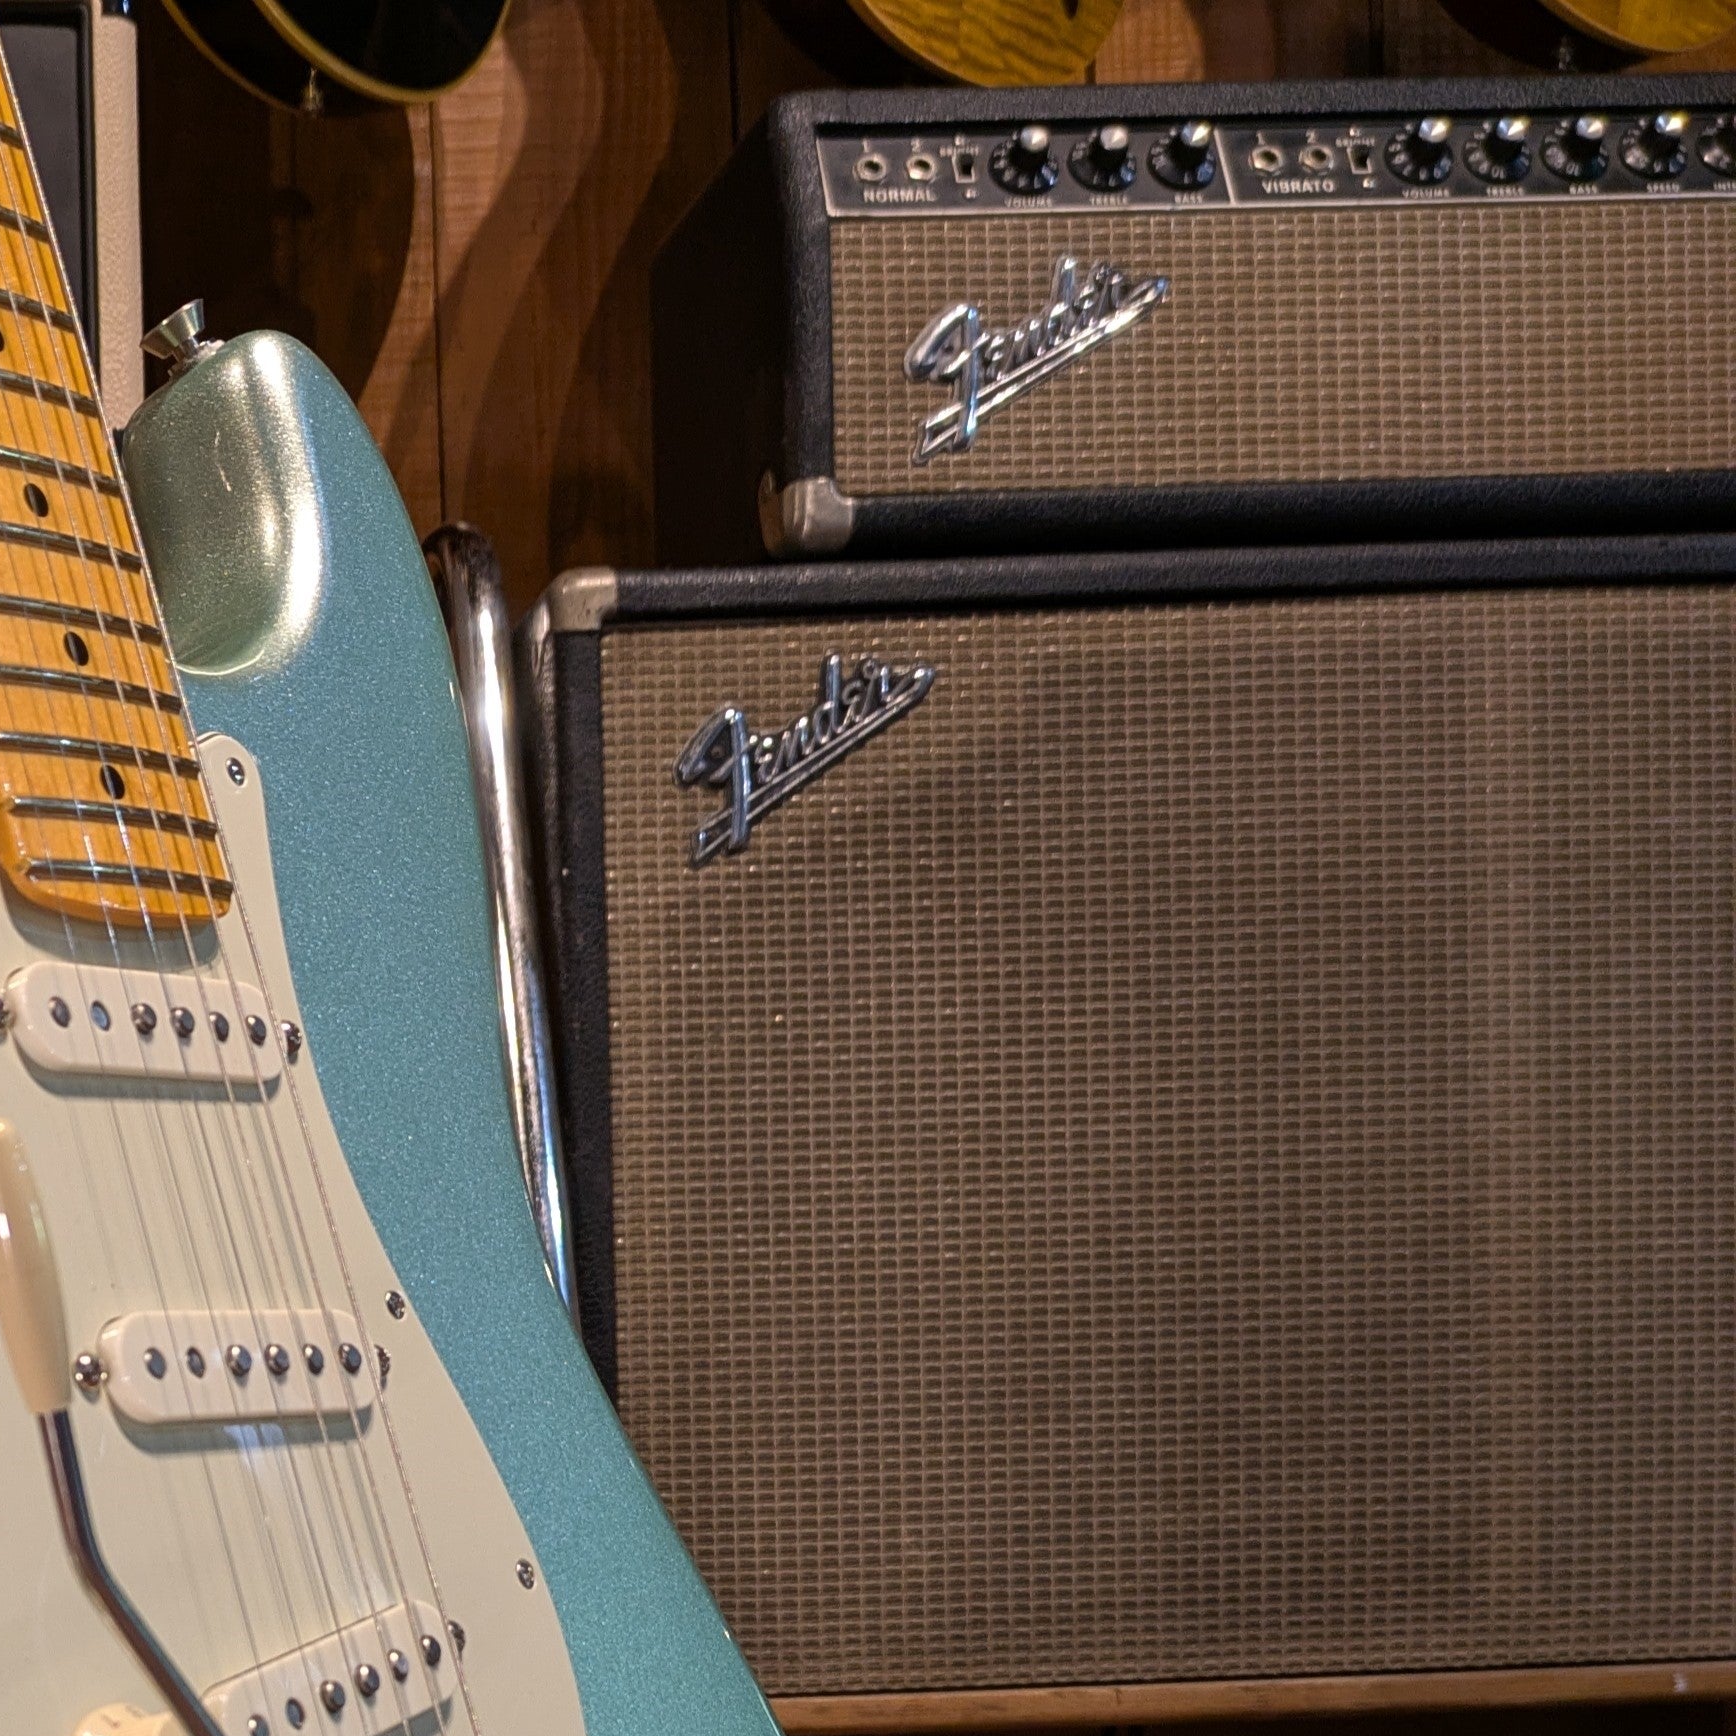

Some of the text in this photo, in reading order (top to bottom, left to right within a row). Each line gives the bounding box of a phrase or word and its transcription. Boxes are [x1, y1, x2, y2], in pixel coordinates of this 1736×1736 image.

[863, 187, 937, 203] NORMAL
[1262, 178, 1336, 194] VIBRATO
[903, 253, 1170, 466] Fender
[672, 653, 937, 870] Fender
